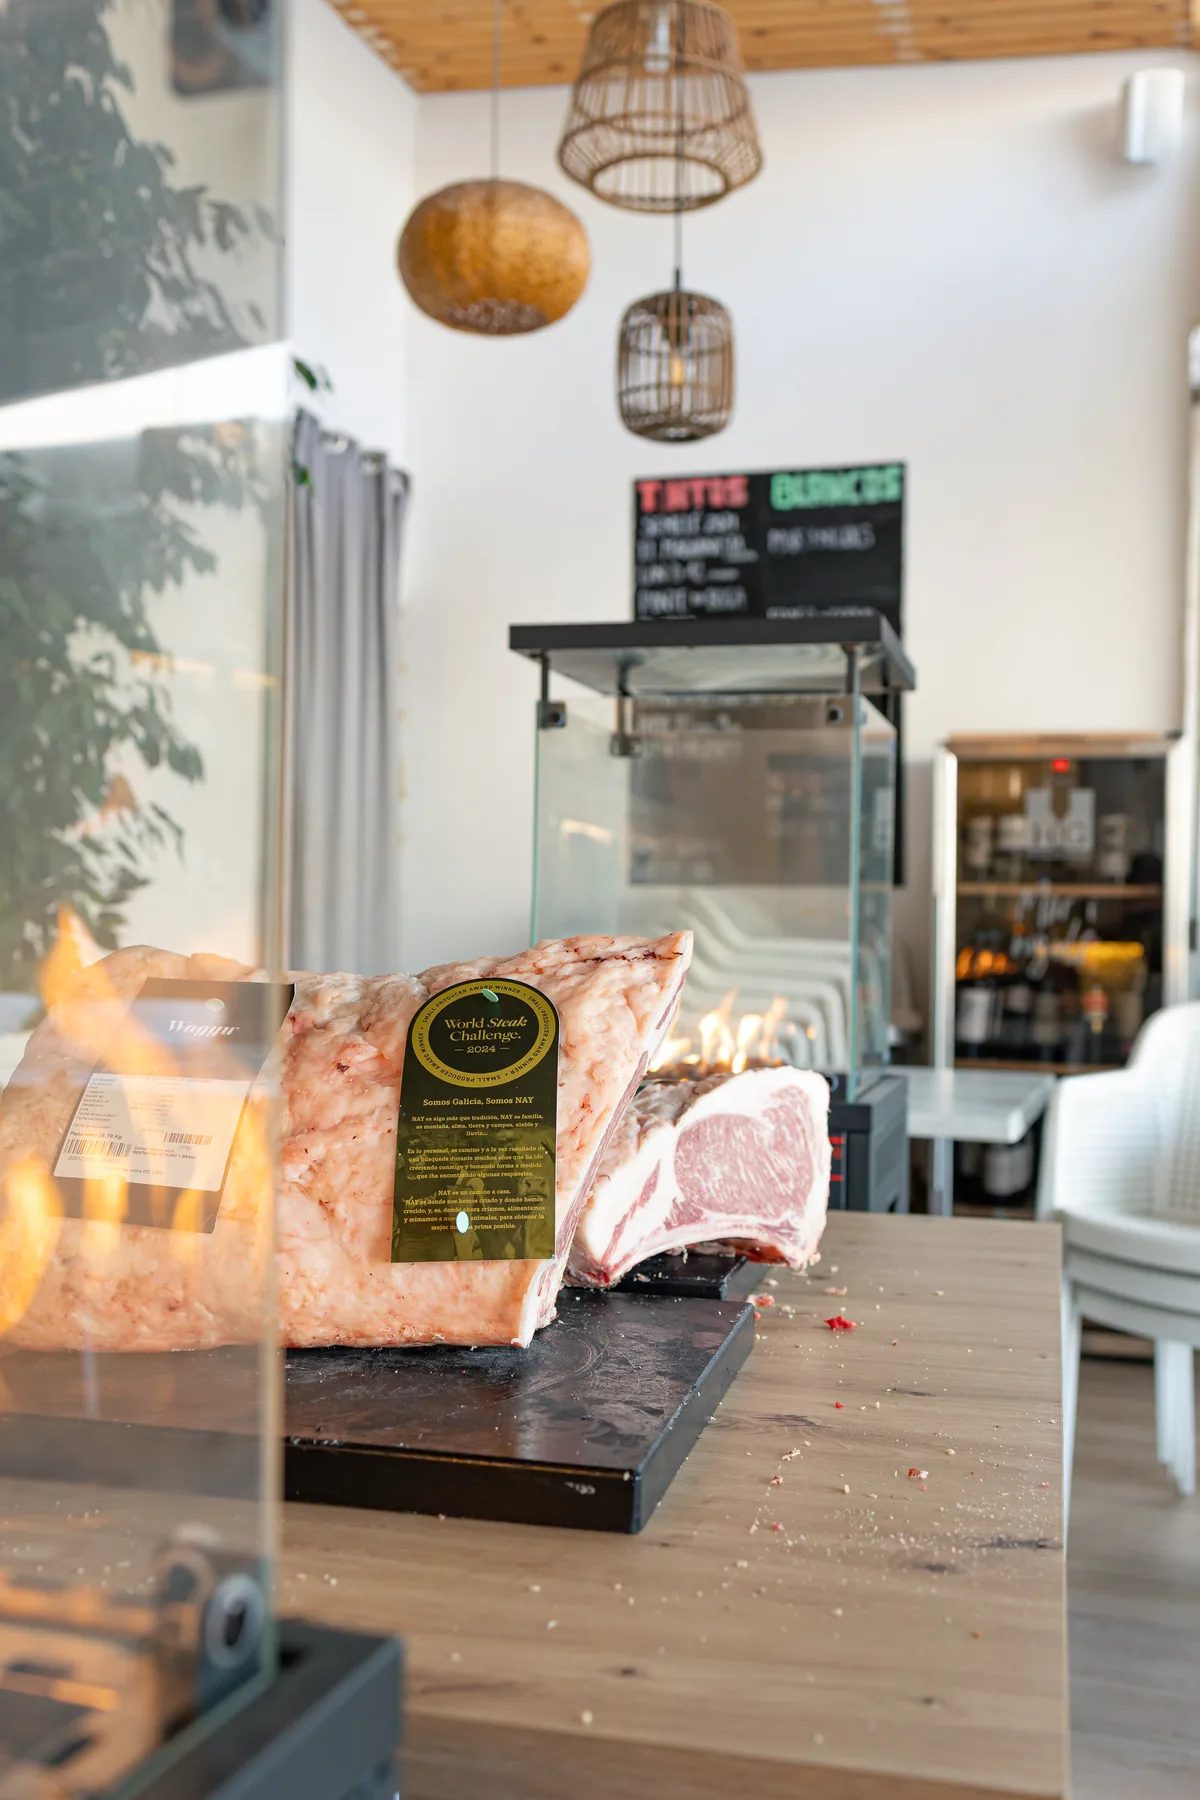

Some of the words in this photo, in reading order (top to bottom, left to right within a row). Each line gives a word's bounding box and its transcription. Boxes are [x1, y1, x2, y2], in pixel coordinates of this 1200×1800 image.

[422, 1008, 436, 1022] SMALL
[436, 989, 467, 1007] PRODUCER
[496, 985, 520, 994] WINNER
[444, 1018, 484, 1029] World
[487, 1016, 527, 1027] Steak
[541, 1010, 550, 1037] PRODUCER
[418, 1032, 426, 1053] WINNER
[450, 1030, 521, 1043] Challenge.
[467, 1045, 496, 1053] 2024
[533, 1038, 546, 1056] AWARD
[424, 1054, 440, 1070] AWARD
[510, 1057, 534, 1074] WINNER
[440, 1069, 474, 1082] PRODUCER
[515, 1096, 534, 1104] NAY
